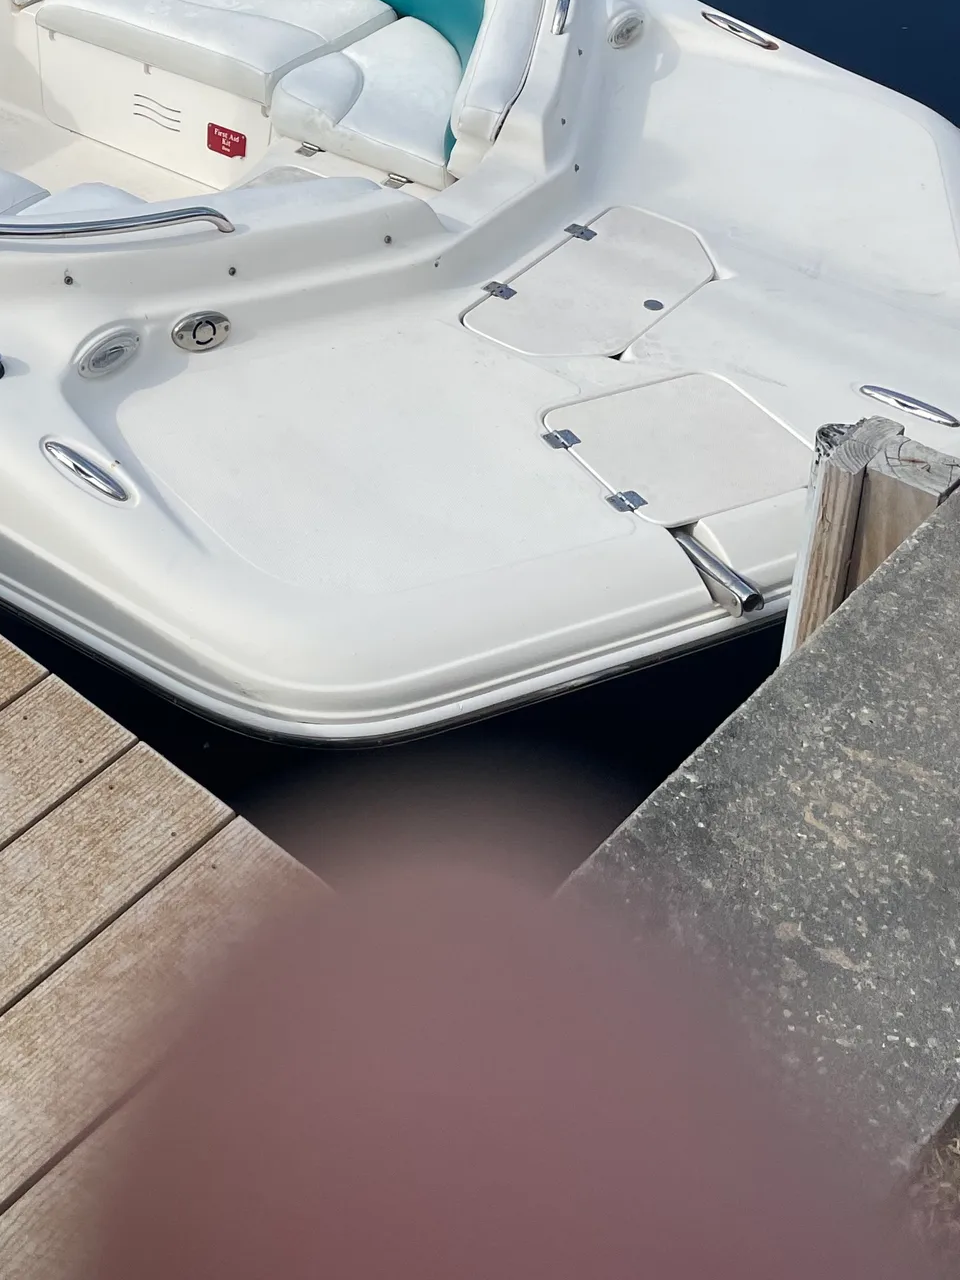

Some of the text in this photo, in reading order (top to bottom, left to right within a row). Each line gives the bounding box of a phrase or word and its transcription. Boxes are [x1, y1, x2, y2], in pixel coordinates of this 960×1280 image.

[214, 127, 240, 143] First Aid
[221, 137, 231, 147] Kit
